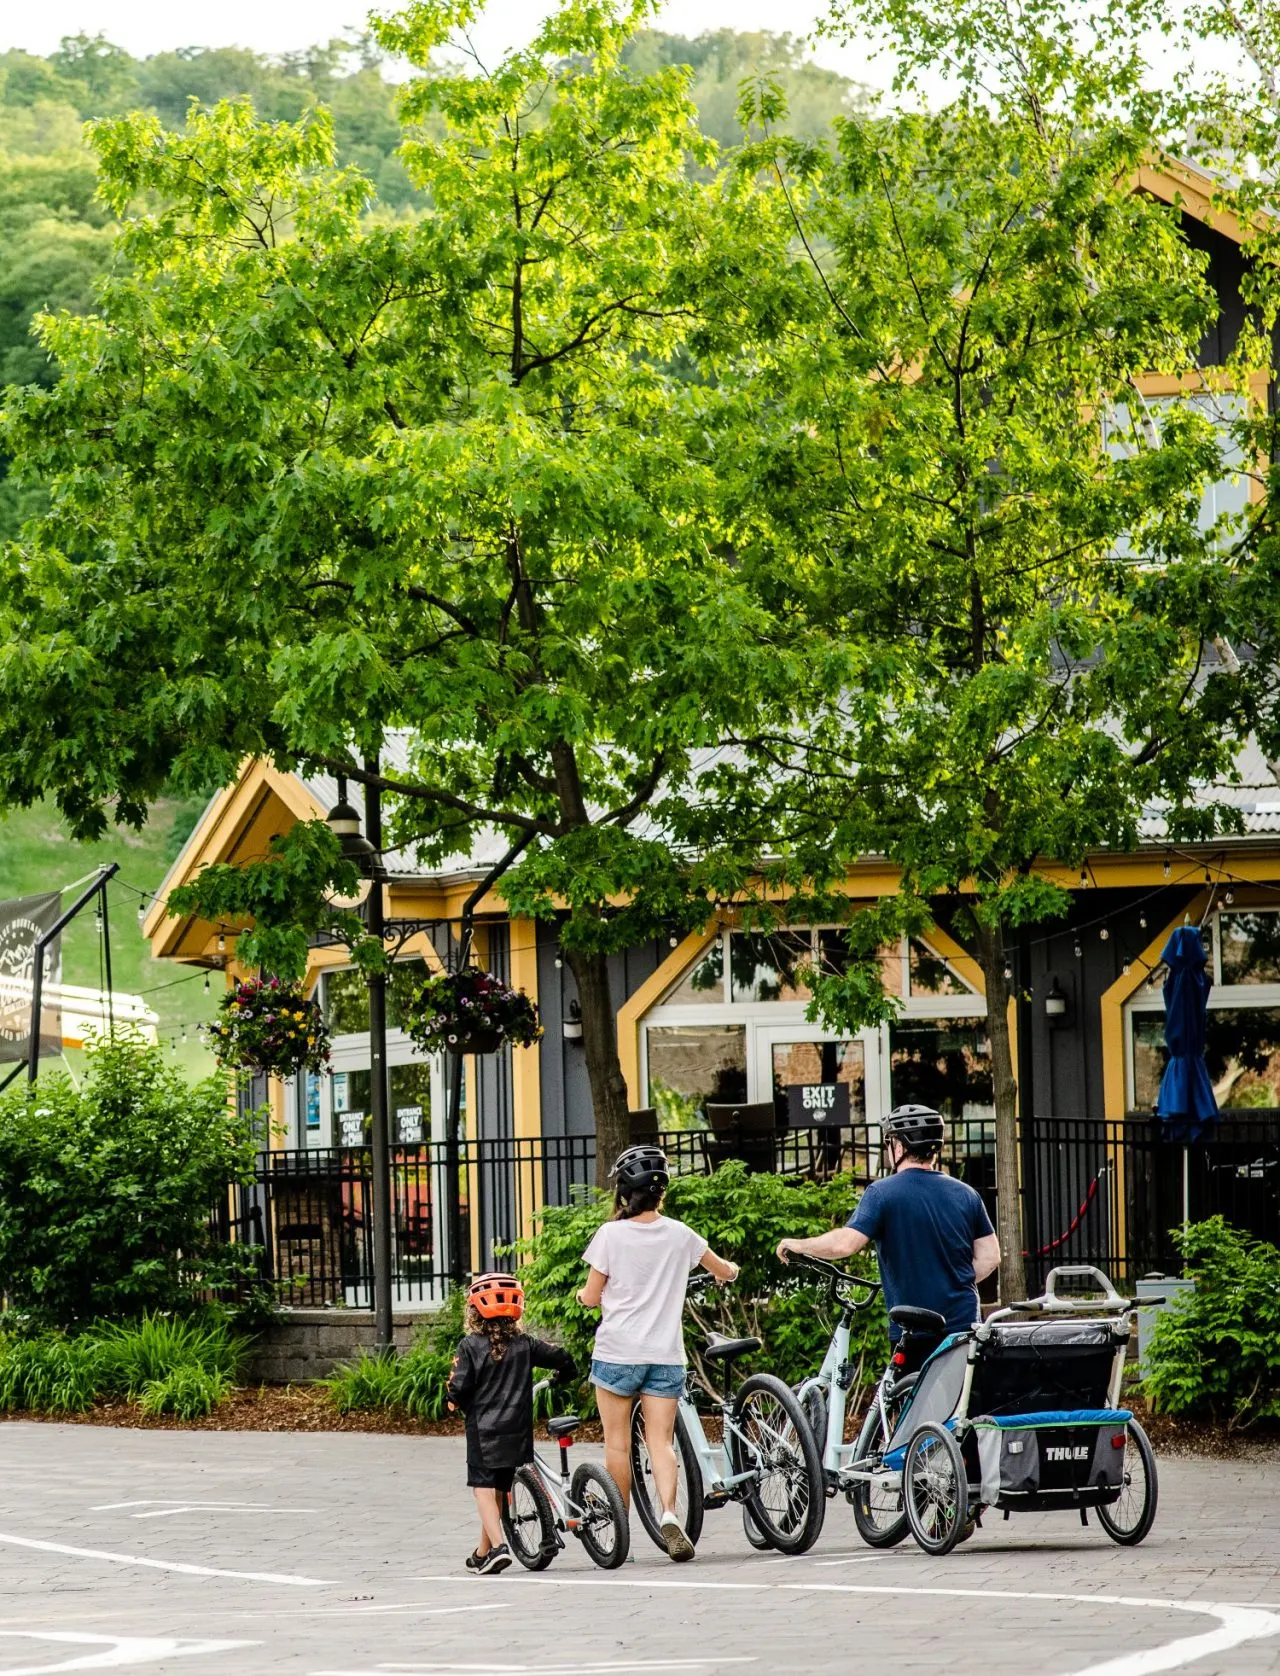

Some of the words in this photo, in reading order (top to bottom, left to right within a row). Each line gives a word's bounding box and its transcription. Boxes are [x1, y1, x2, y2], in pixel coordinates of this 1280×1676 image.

[11, 918, 43, 938] MOUNTAIN
[802, 1085, 836, 1099] EXIT
[802, 1097, 835, 1109] ONLY
[339, 1111, 364, 1122] ENTRANCE
[397, 1106, 423, 1118] ENTRANCE
[343, 1121, 361, 1133] ONLY
[400, 1116, 420, 1128] ONLY
[1046, 1446, 1089, 1460] THULE
